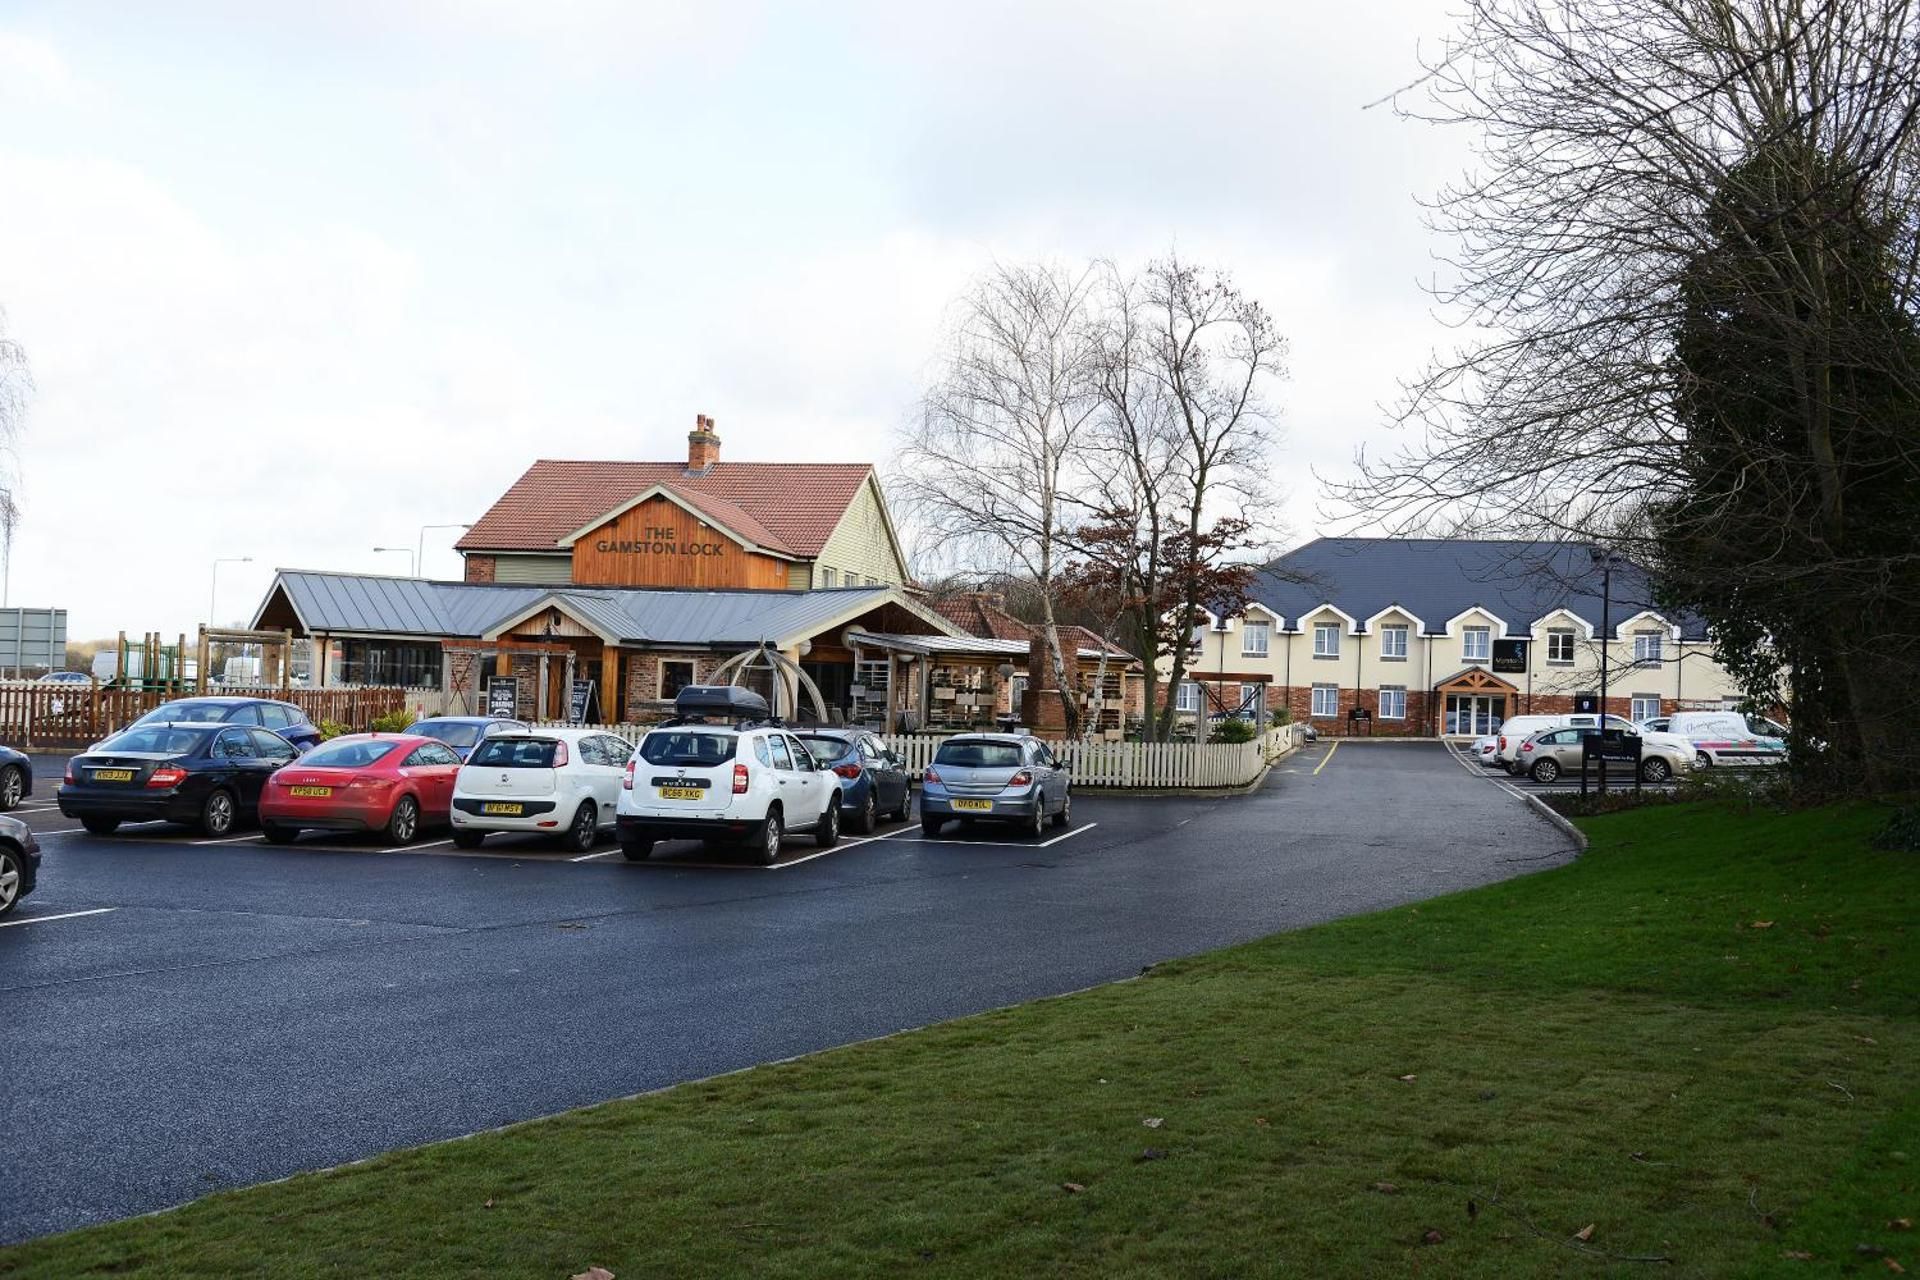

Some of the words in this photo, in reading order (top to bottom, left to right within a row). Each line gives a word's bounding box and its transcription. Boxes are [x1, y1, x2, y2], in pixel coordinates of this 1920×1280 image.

[645, 527, 674, 540] THE
[597, 540, 676, 555] GAMSTON
[680, 543, 723, 556] LOCK
